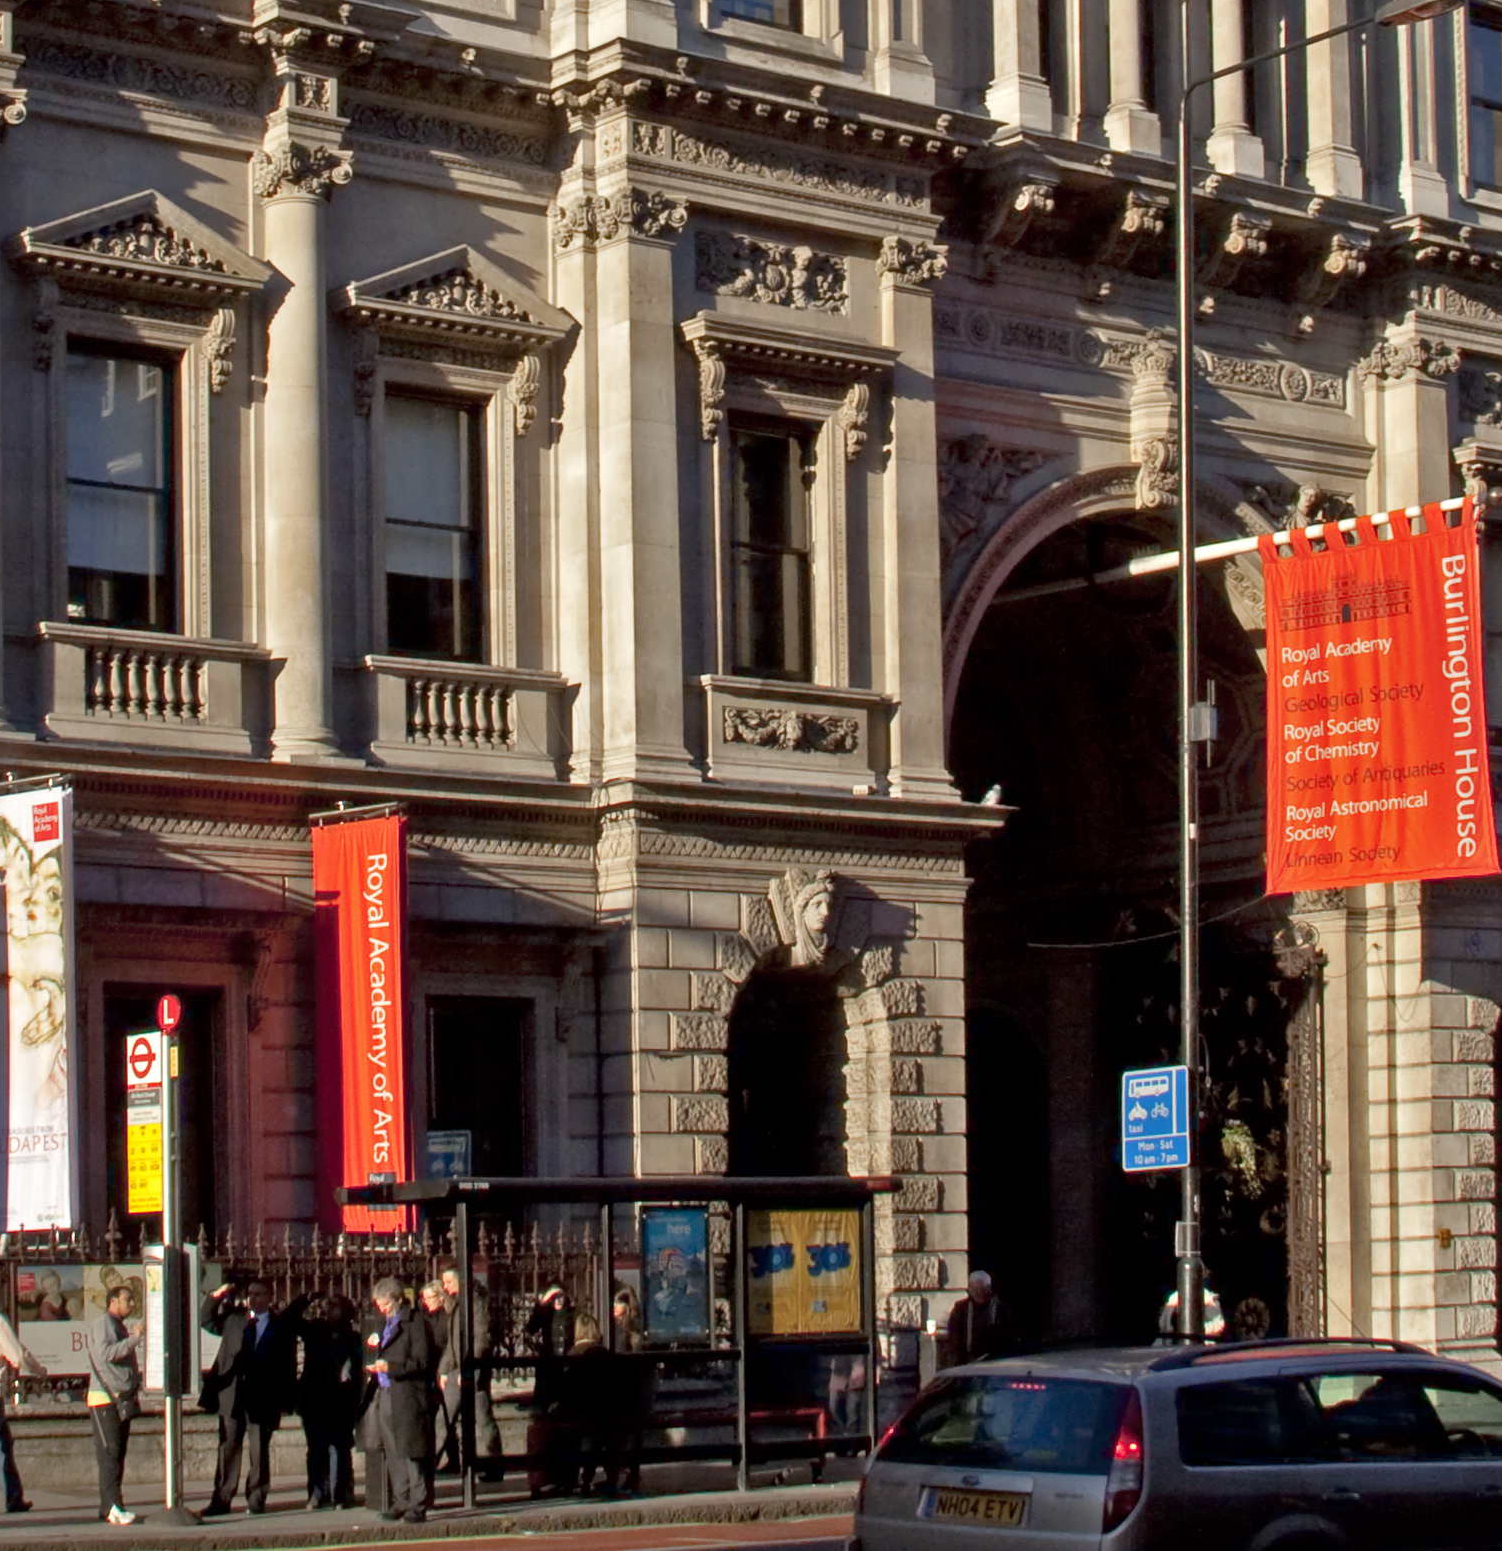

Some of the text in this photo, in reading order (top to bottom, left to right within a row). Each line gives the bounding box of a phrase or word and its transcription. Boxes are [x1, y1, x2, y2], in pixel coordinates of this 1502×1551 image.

[1281, 637, 1393, 666] Royal Academy
[1282, 668, 1330, 688] of Arts
[1284, 682, 1424, 713] Geological Society
[1441, 554, 1479, 858] Burlington House
[1284, 716, 1381, 743] Royal Society
[1285, 740, 1379, 764] of Chemistry
[1286, 760, 1445, 792] Society of Antiquaries
[1286, 790, 1428, 824] Royal Astronomical
[1285, 824, 1337, 843] Society
[1286, 844, 1402, 868] Linnean Society
[163, 999, 174, 1025] L
[362, 853, 394, 1164] Royal Academy of Arts
[1128, 1123, 1143, 1133] taxi
[1138, 1141, 1155, 1151] Mon
[1160, 1139, 1174, 1150] Sat
[667, 1222, 692, 1235] here
[936, 1495, 1021, 1520] NH04 ETV
